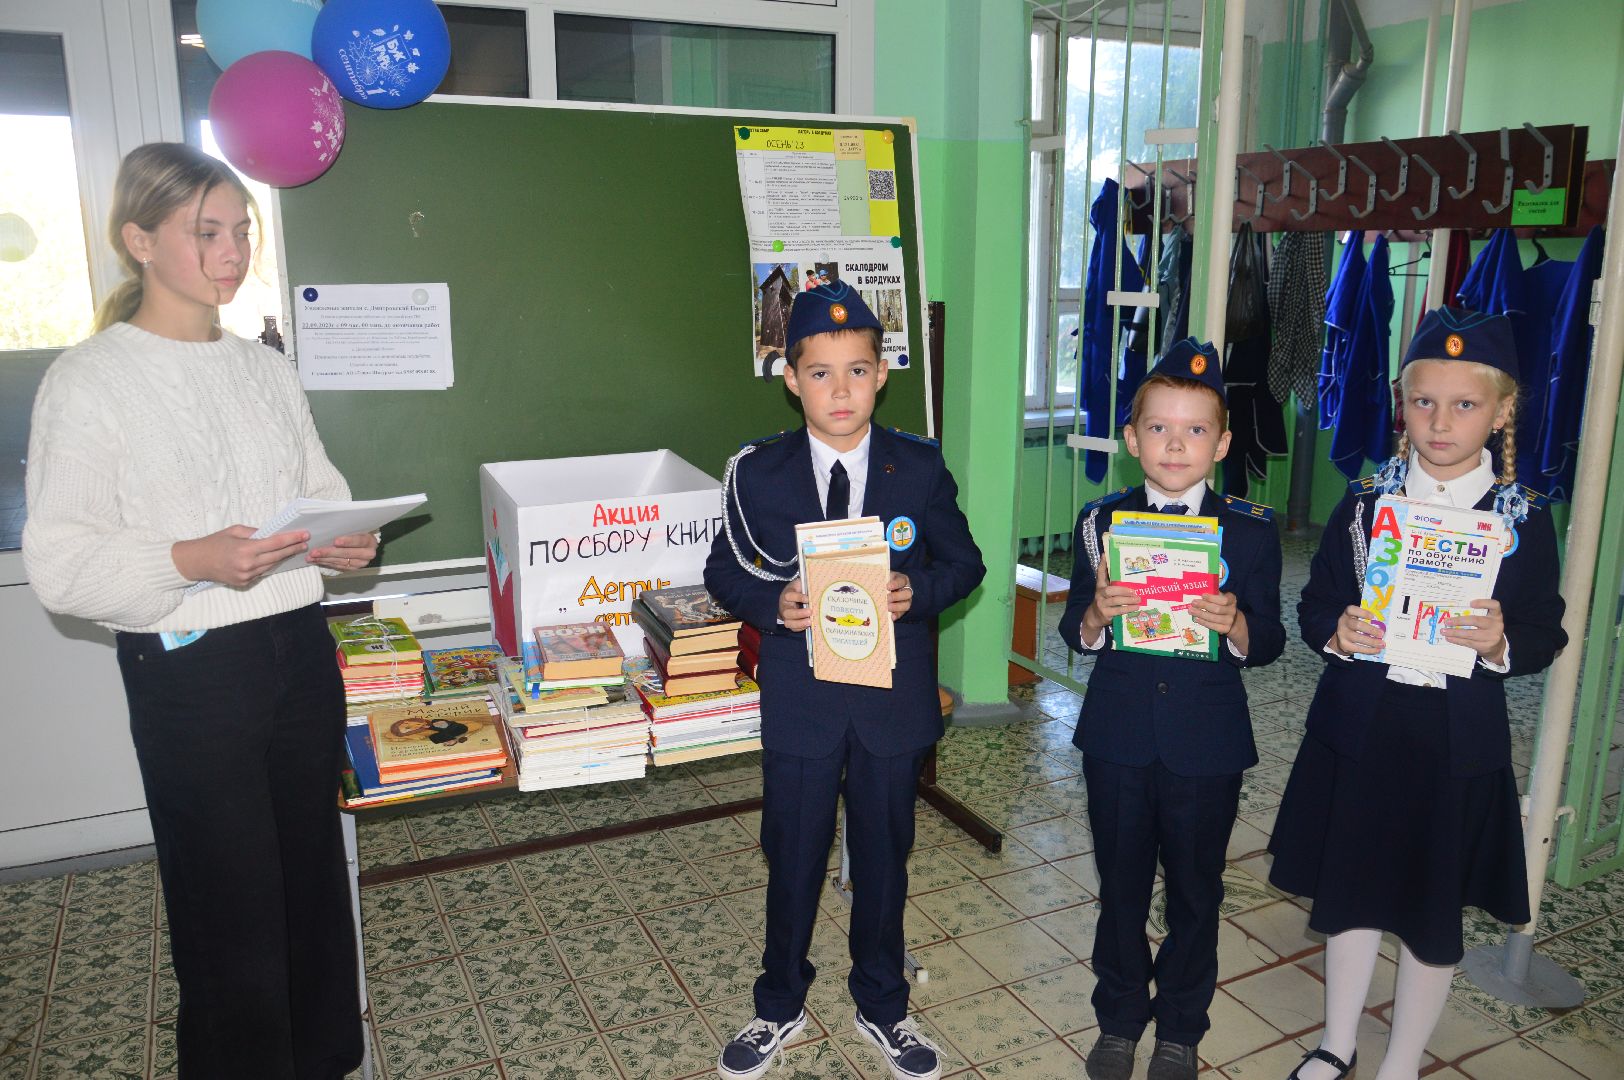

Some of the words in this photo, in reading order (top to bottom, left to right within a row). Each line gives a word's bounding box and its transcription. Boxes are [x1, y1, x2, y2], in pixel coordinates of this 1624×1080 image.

[845, 262, 889, 273] СКАЛОДРОМ
[857, 275, 863, 284] В
[865, 275, 901, 286] БОРДУКАХ
[529, 537, 570, 566] ПО
[577, 527, 652, 559] СБОРУ
[1410, 533, 1488, 558] ТЕСТЫ
[1406, 557, 1453, 569] грамоте
[1408, 548, 1422, 556] по
[1426, 551, 1485, 565] обучению
[1134, 582, 1181, 597] ГЛИЙСКИЙ
[830, 605, 864, 614] ПОВЕСТИ
